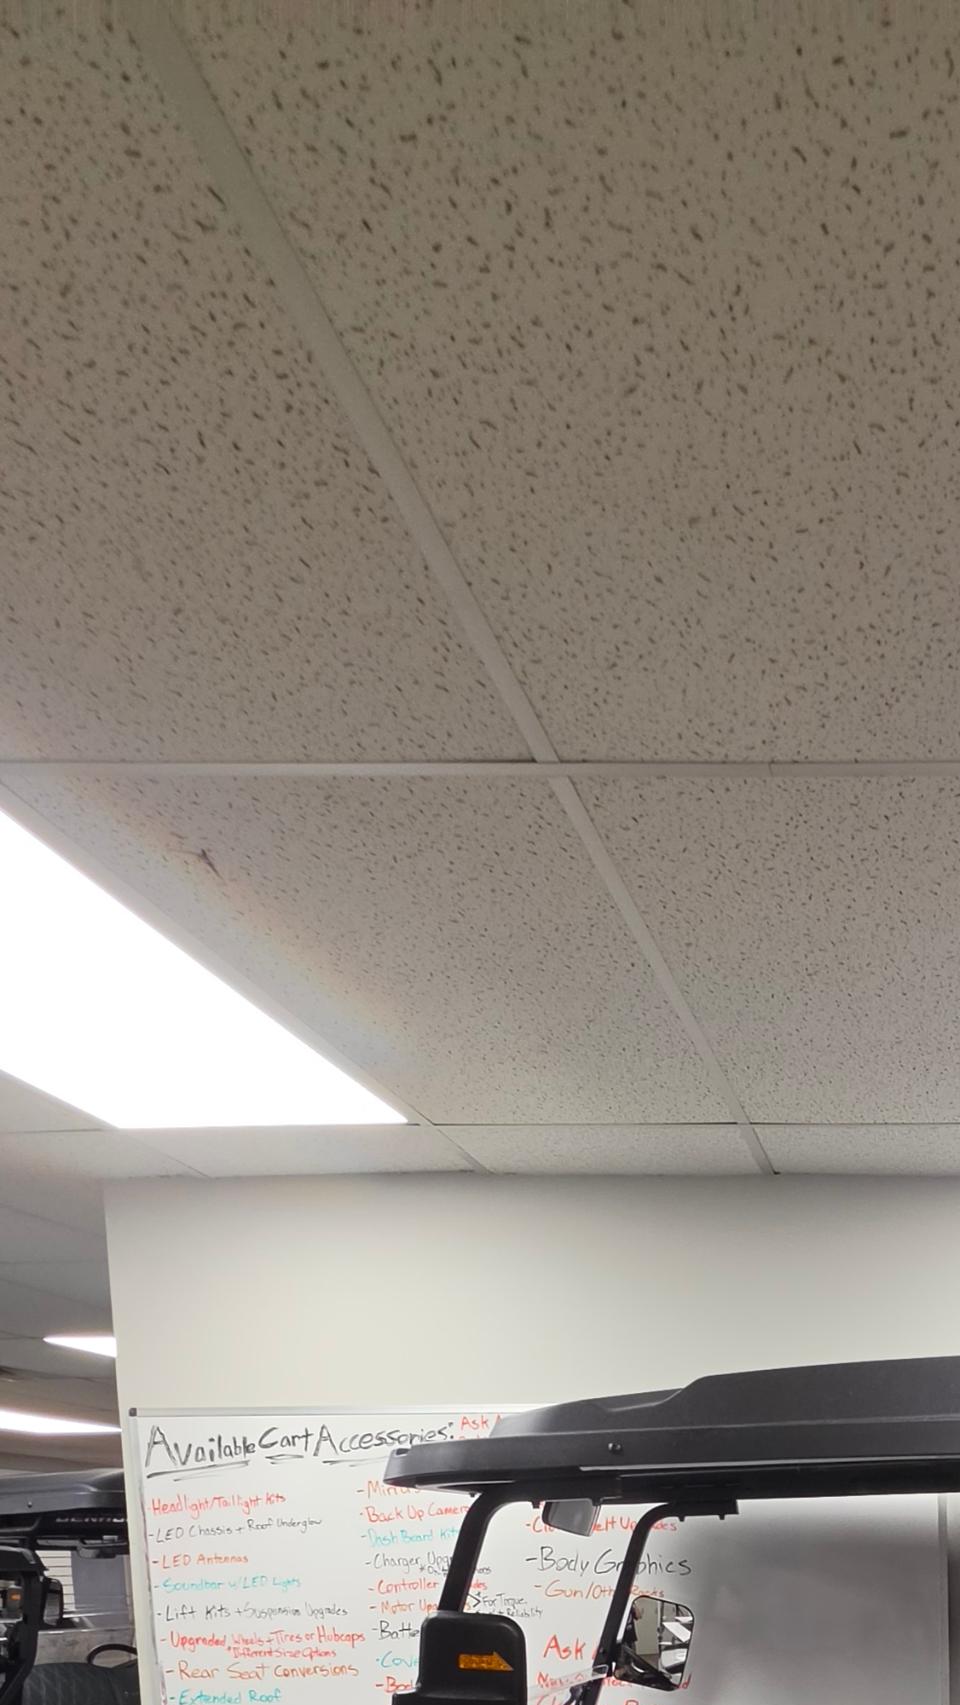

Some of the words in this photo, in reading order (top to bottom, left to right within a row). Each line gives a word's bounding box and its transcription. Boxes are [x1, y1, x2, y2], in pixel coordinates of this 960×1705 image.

[145, 1424, 256, 1467] Available
[259, 1426, 313, 1451] Cart
[265, 1492, 286, 1504] Kits
[365, 1505, 403, 1523] Back
[407, 1504, 425, 1521] Up
[156, 1527, 184, 1543] LED
[189, 1524, 233, 1538] Chassis
[247, 1518, 274, 1533] Roof
[276, 1518, 323, 1534] Underglow
[400, 1529, 433, 1543] Board
[161, 1554, 191, 1569] LED
[196, 1554, 249, 1567] Antennas
[374, 1553, 420, 1574] Charger
[537, 1545, 589, 1577] Body
[162, 1577, 223, 1594] Soundbar
[378, 1578, 439, 1595] Controller
[380, 1600, 415, 1614] Motor
[482, 1596, 497, 1607] For
[166, 1604, 197, 1622] Lift
[205, 1604, 231, 1621] Kits
[304, 1602, 349, 1620] Upgrades
[170, 1631, 226, 1653] Upgraded
[316, 1625, 366, 1649] Hubcaps
[543, 1634, 586, 1660] Ask
[300, 1648, 338, 1661] Options
[178, 1660, 220, 1681] Rear
[226, 1662, 270, 1681] Seat
[273, 1663, 360, 1678] Conversions
[179, 1688, 241, 1705] Extended
[249, 1688, 281, 1704] Roof
